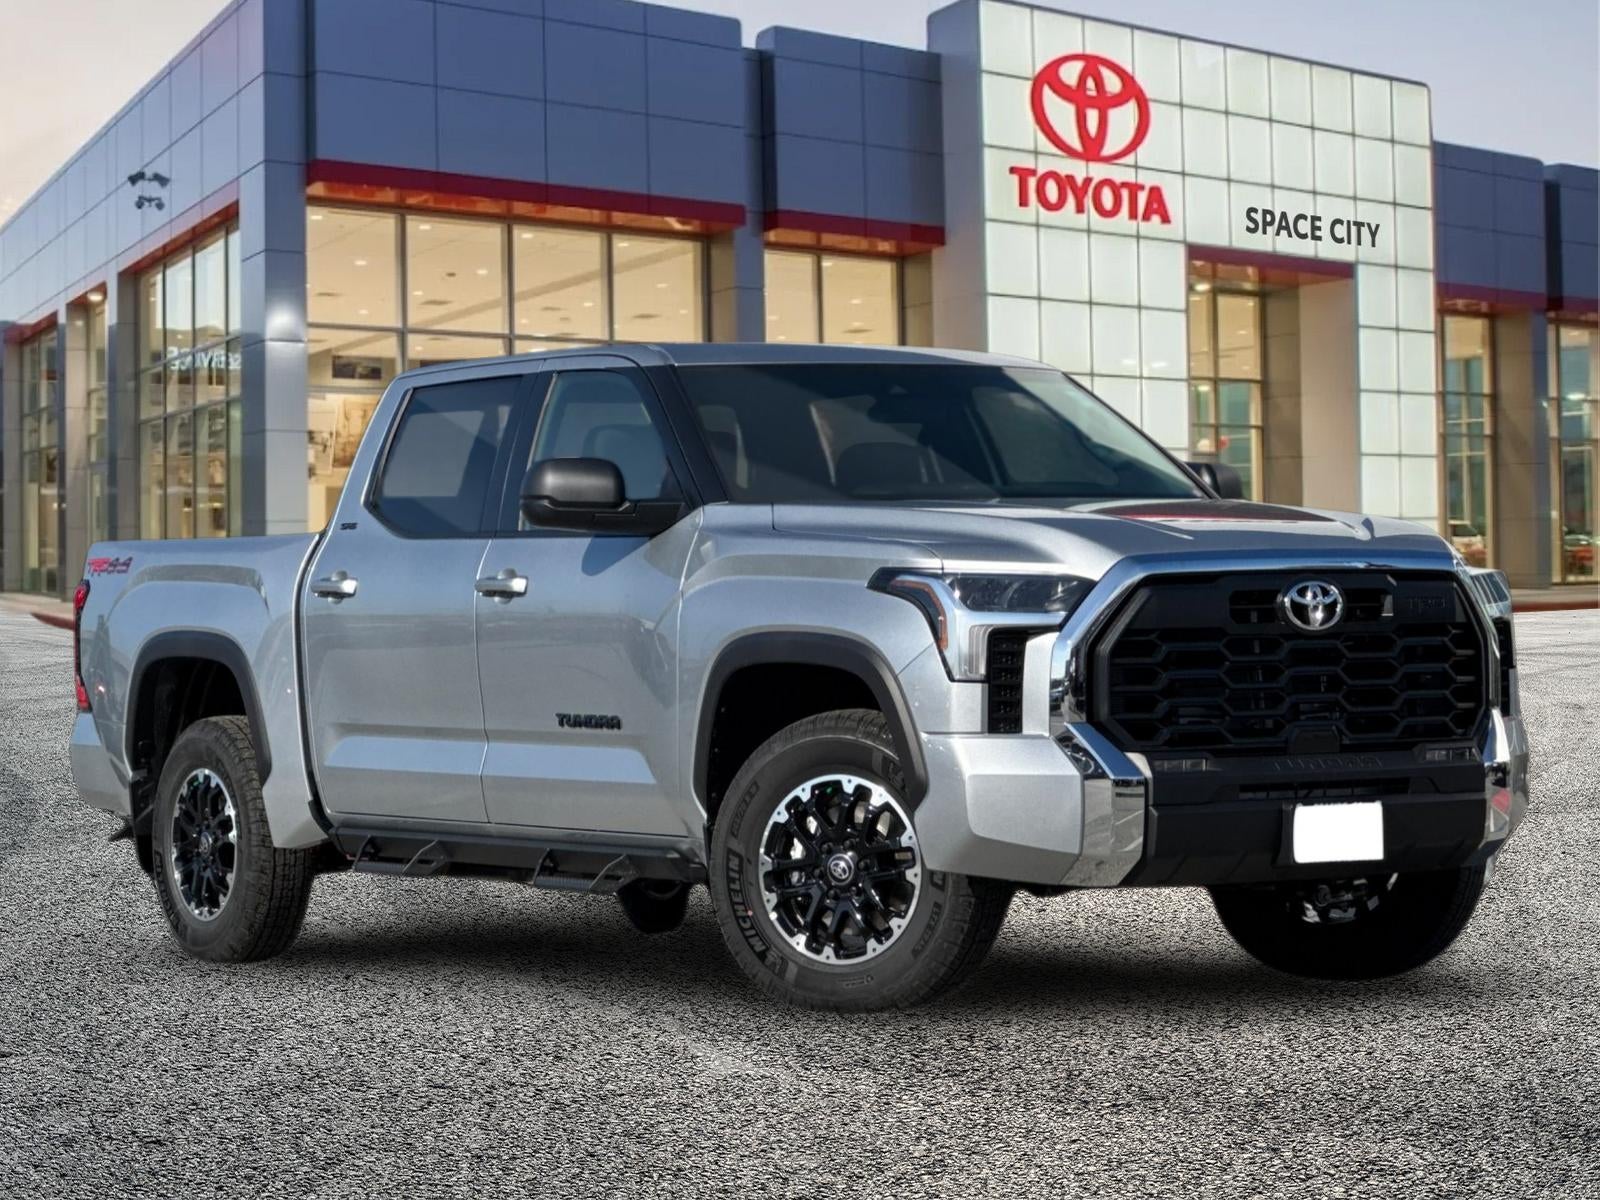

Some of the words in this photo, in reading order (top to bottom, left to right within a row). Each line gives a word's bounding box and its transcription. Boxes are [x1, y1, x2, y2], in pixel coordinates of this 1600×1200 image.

[1009, 166, 1171, 224] TOYOTA
[1245, 206, 1323, 242] SPACE
[1329, 218, 1380, 248] CITY
[555, 713, 622, 730] TUNDRA
[727, 853, 768, 954] MICHELIN
